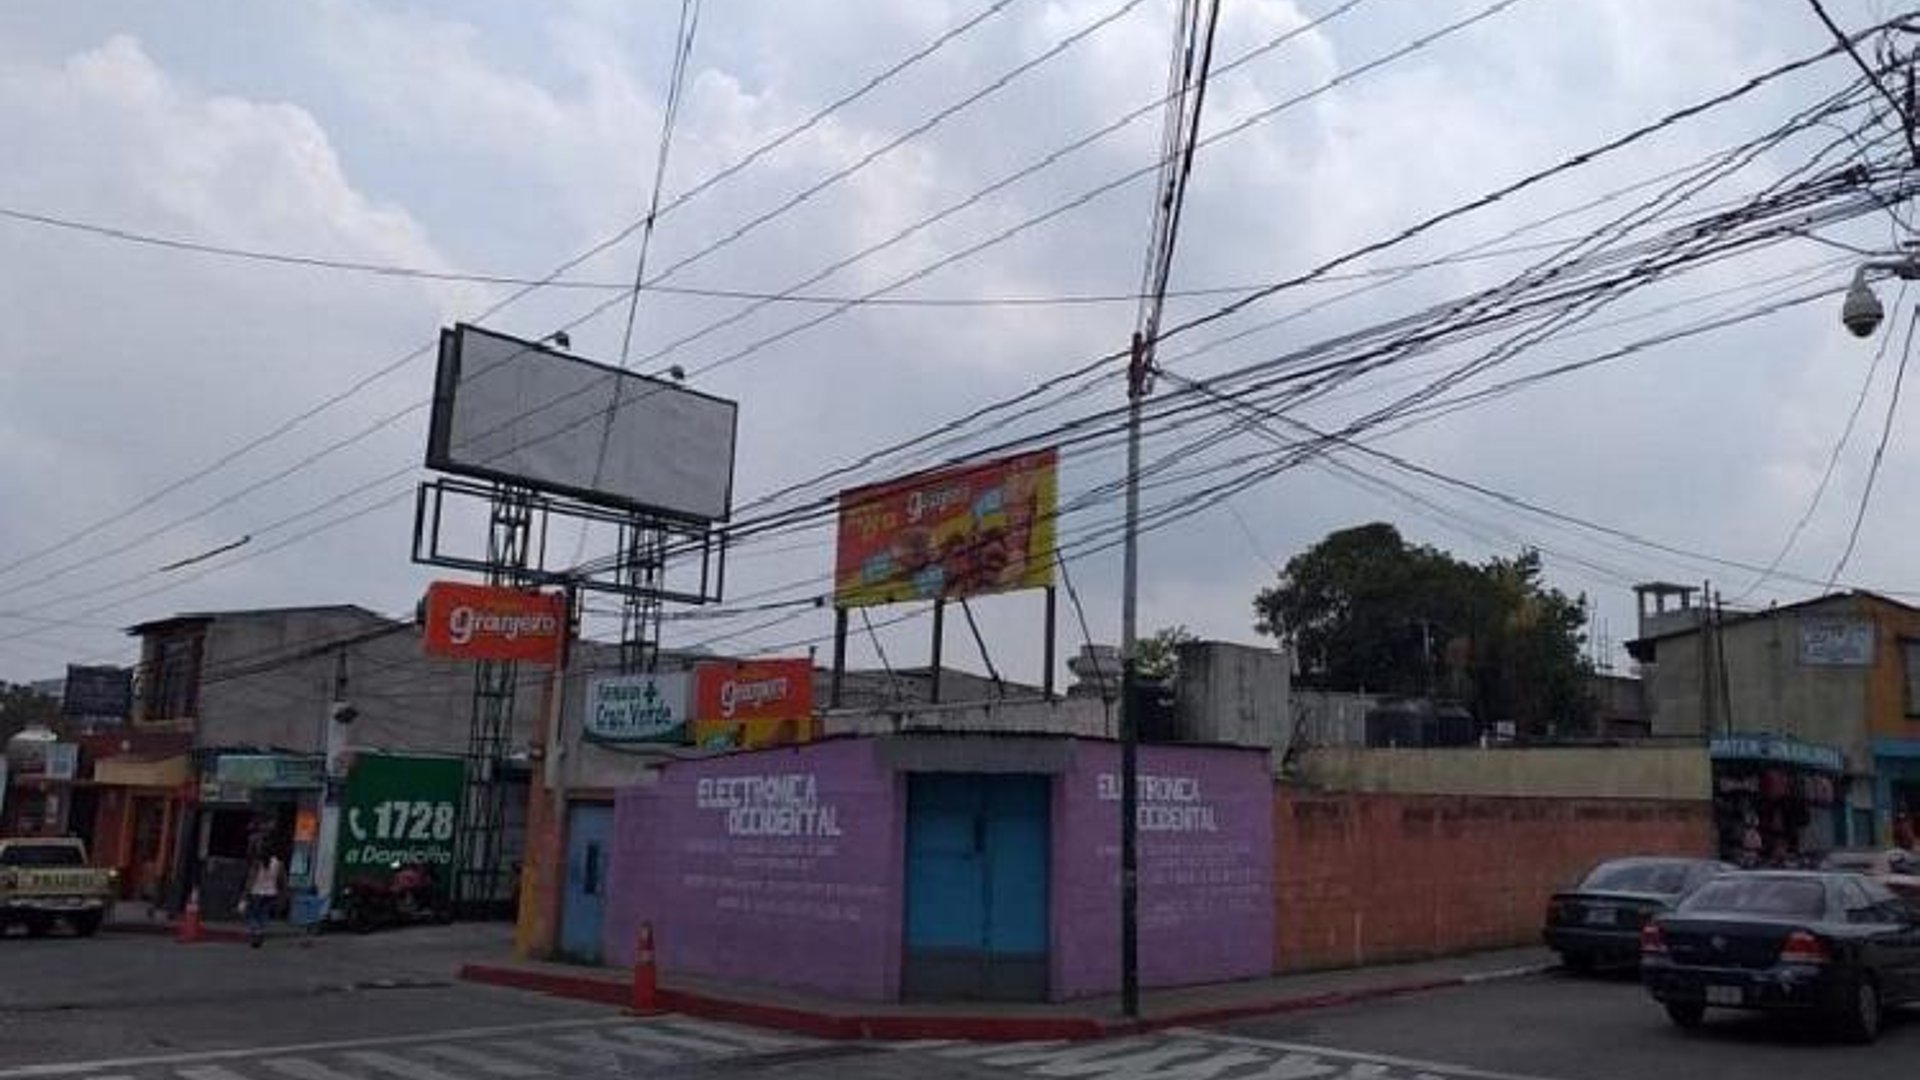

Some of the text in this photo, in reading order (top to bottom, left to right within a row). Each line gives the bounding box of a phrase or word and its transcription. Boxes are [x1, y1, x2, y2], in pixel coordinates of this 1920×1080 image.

[1097, 774, 1201, 801] ELTRONICA
[373, 800, 454, 841] 1728
[1135, 804, 1218, 832] CCIDENTAL
